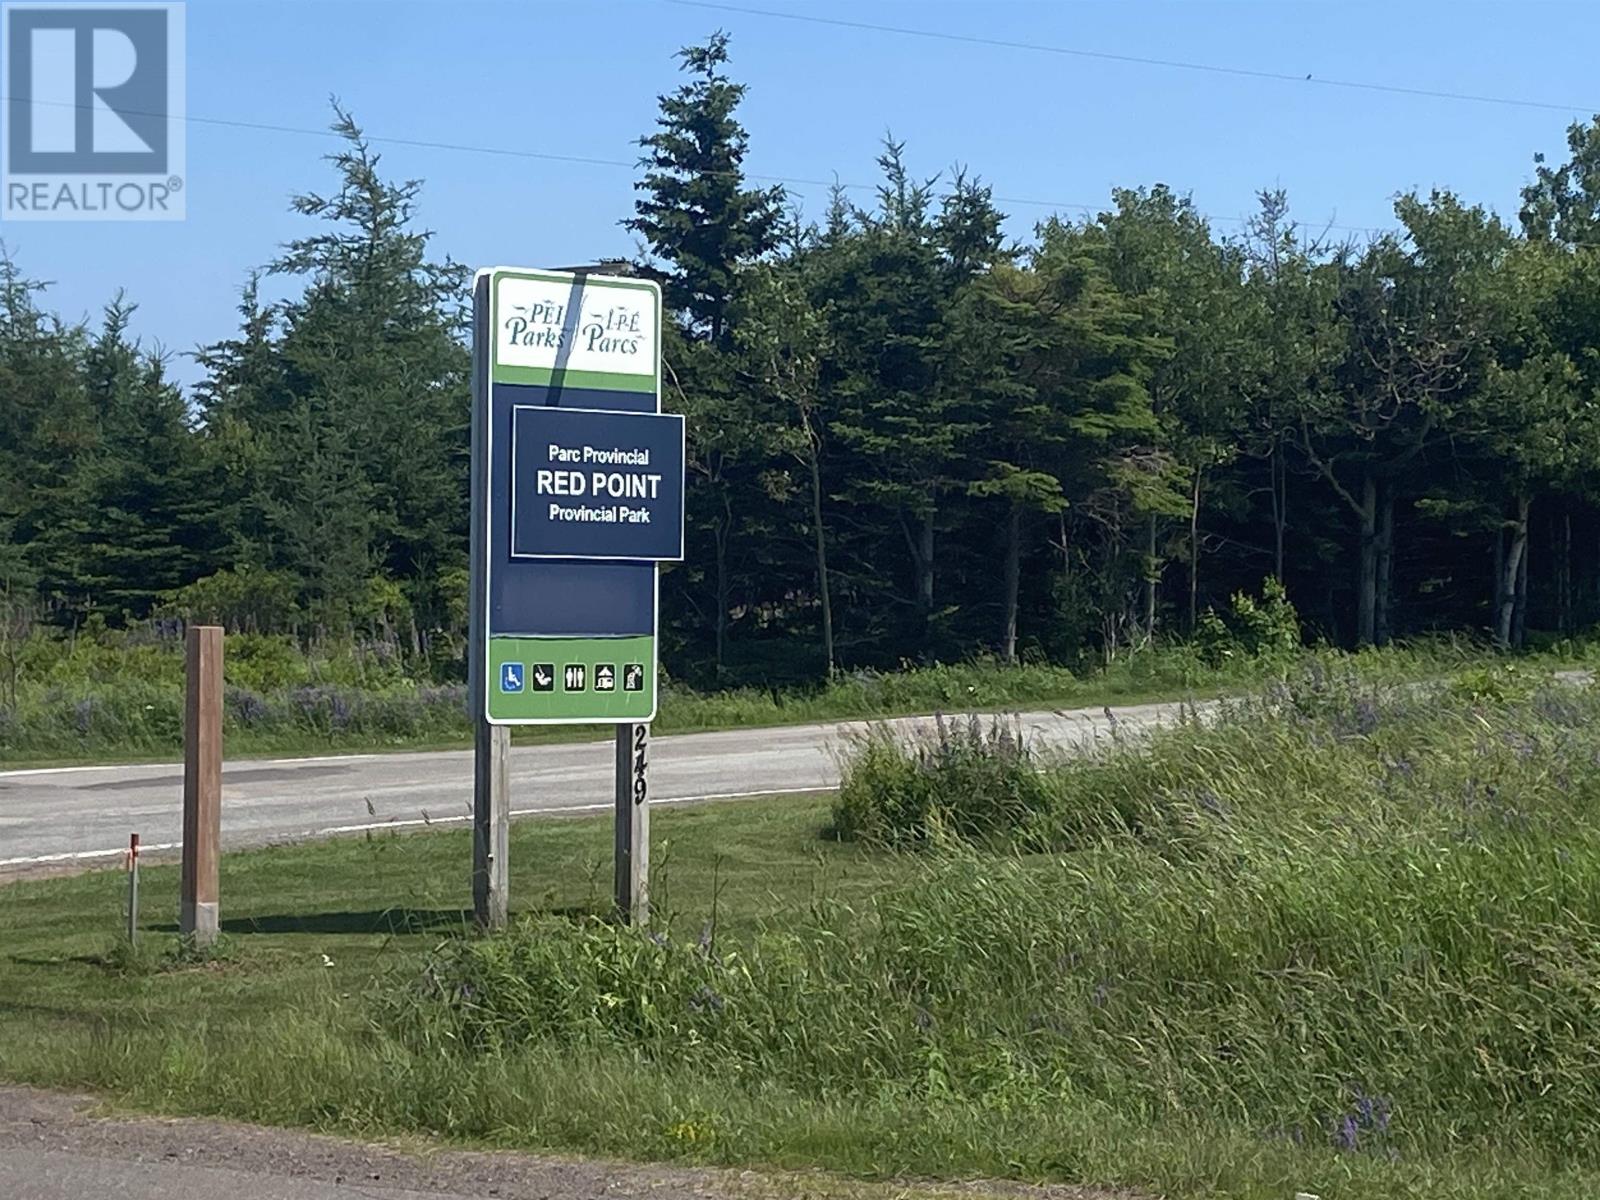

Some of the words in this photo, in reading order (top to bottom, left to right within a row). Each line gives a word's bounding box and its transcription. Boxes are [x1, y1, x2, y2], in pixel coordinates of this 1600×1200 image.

[529, 303, 563, 325] PEI
[505, 316, 565, 348] Parks
[582, 323, 638, 355] Parcs
[549, 444, 581, 462] Parc
[583, 446, 649, 465] Provincial
[537, 470, 586, 496] RED
[592, 472, 661, 499] POINT
[549, 503, 616, 523] Provincial
[619, 506, 650, 524] Park
[634, 725, 648, 806] 249
